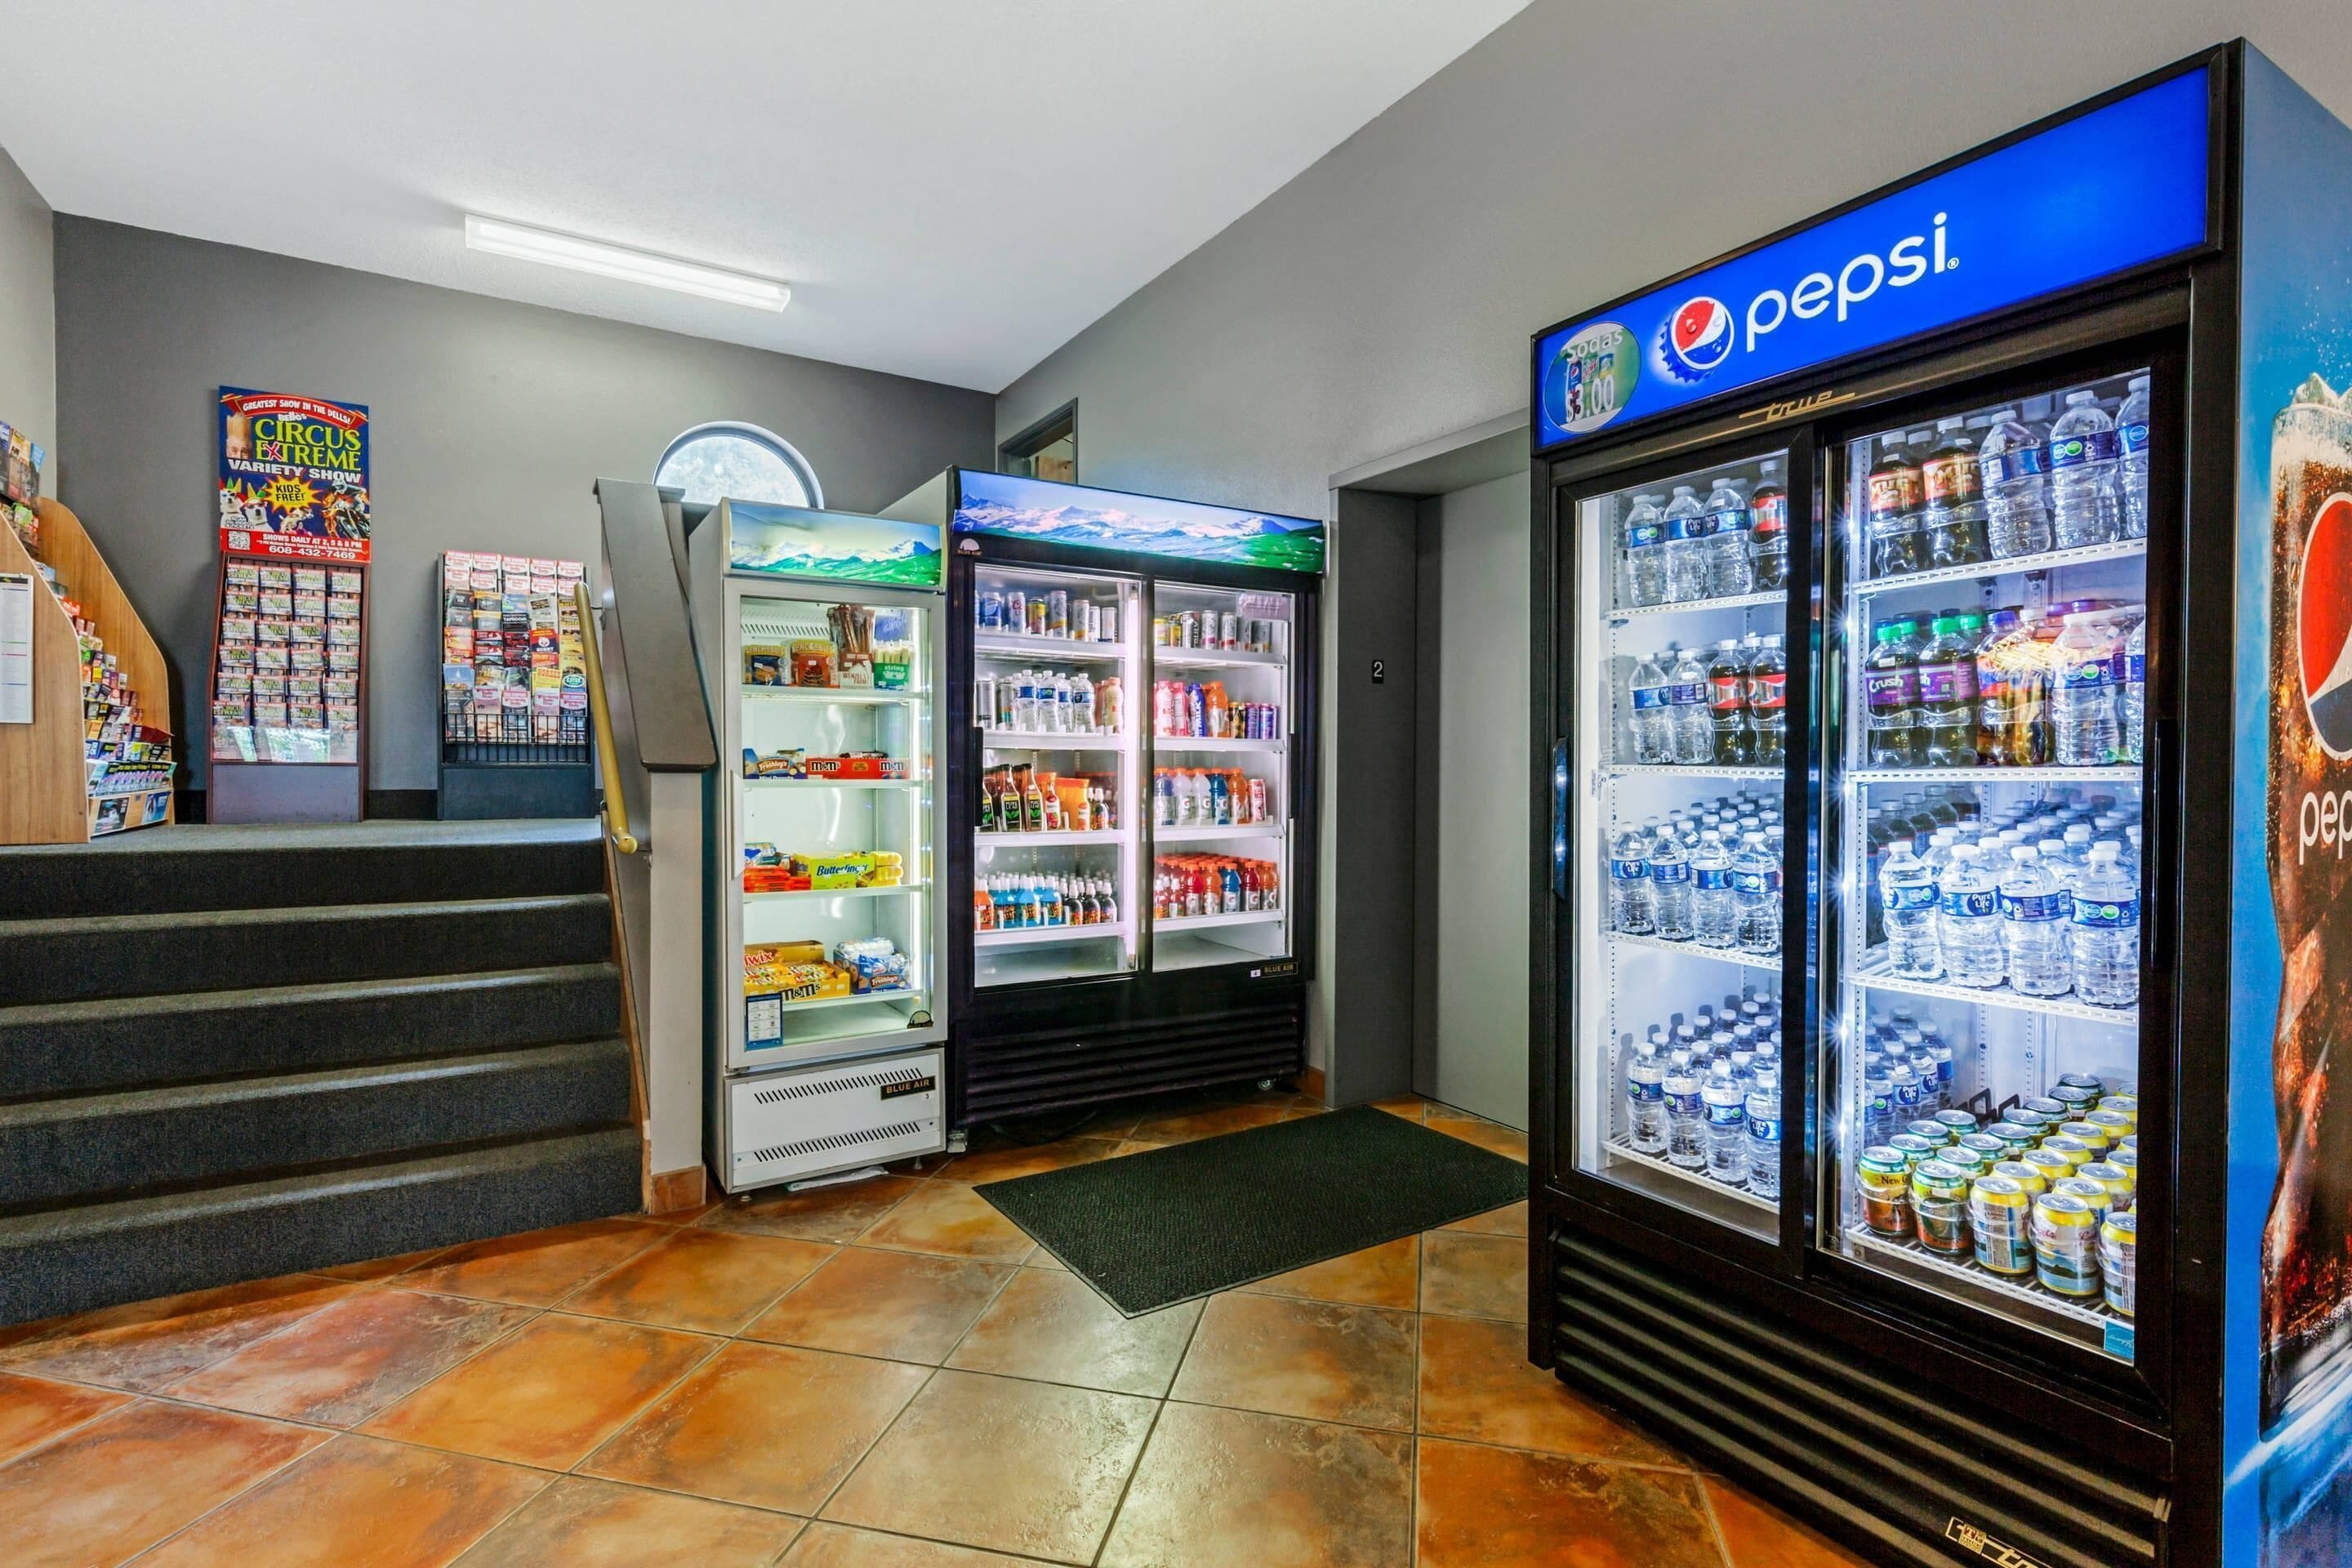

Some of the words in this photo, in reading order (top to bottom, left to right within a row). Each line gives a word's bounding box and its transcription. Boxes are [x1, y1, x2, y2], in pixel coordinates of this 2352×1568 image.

[1746, 212, 1948, 354] pepsi
[1566, 328, 1624, 363] Sodas
[1566, 374, 1615, 423] $3.00
[243, 399, 278, 412] GREATEST
[279, 399, 301, 409] SHOW
[302, 401, 311, 410] IN
[313, 403, 326, 415] THE
[327, 409, 351, 425] DELLS!
[255, 418, 362, 451] CIRCUS
[256, 439, 362, 471] EXTREME
[228, 458, 305, 477] VARIETY
[309, 468, 362, 484] SHOW
[275, 483, 301, 493] KIDS
[275, 492, 305, 502] FREE!
[263, 533, 290, 543] SHOWS
[292, 536, 311, 545] DAILY
[351, 541, 362, 549] PM
[269, 545, 356, 560] 608-432-7469
[1373, 660, 1383, 678] 2
[1869, 675, 1904, 693] Crush
[817, 863, 870, 876] Butterfingr
[1975, 899, 1990, 909] Life
[1264, 965, 1281, 973] BLUE
[886, 1082, 912, 1094] BLUE
[914, 1079, 930, 1089] AIR
[1881, 1176, 1900, 1185] New
